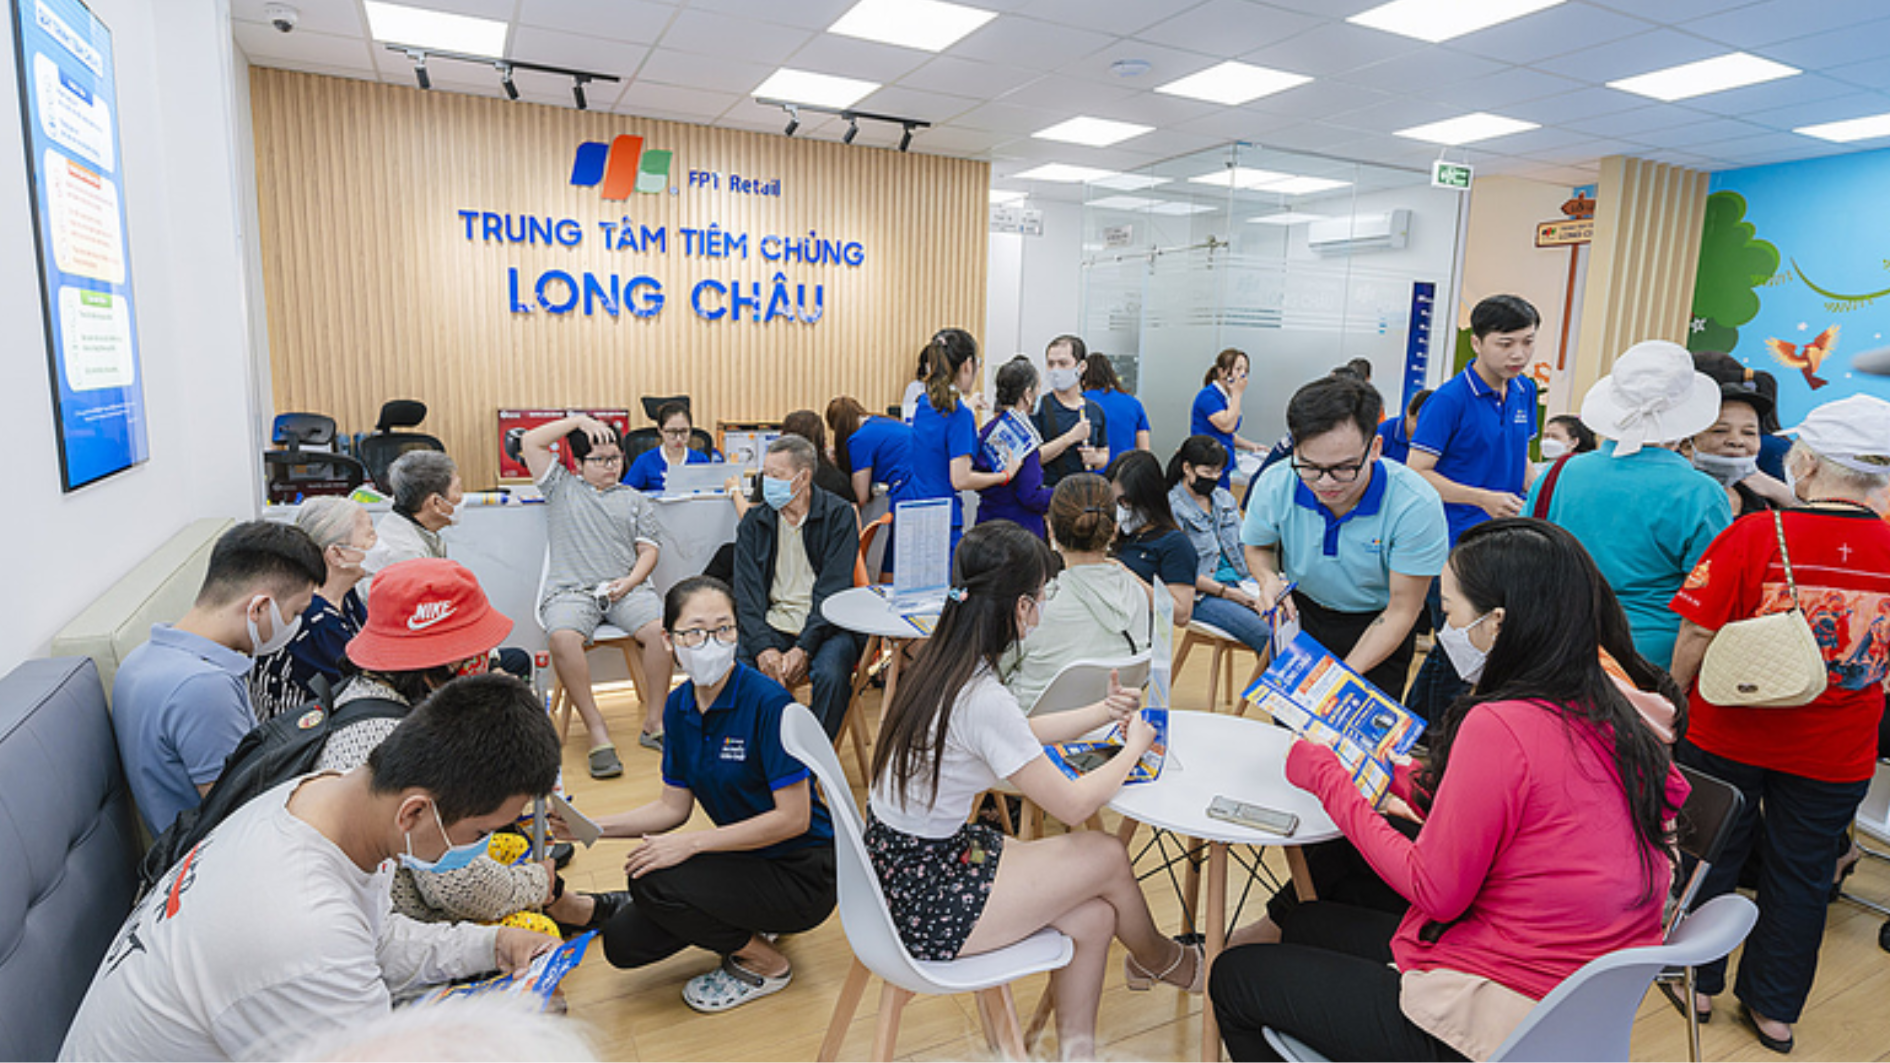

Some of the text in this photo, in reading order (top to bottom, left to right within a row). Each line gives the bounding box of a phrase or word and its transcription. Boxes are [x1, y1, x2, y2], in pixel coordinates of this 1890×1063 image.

[689, 169, 782, 197] FPT Retail
[458, 209, 865, 267] TRUNG TÂM TIÊM CHỦNG
[508, 267, 824, 324] LONG CHÂU
[414, 600, 452, 621] NIKE
